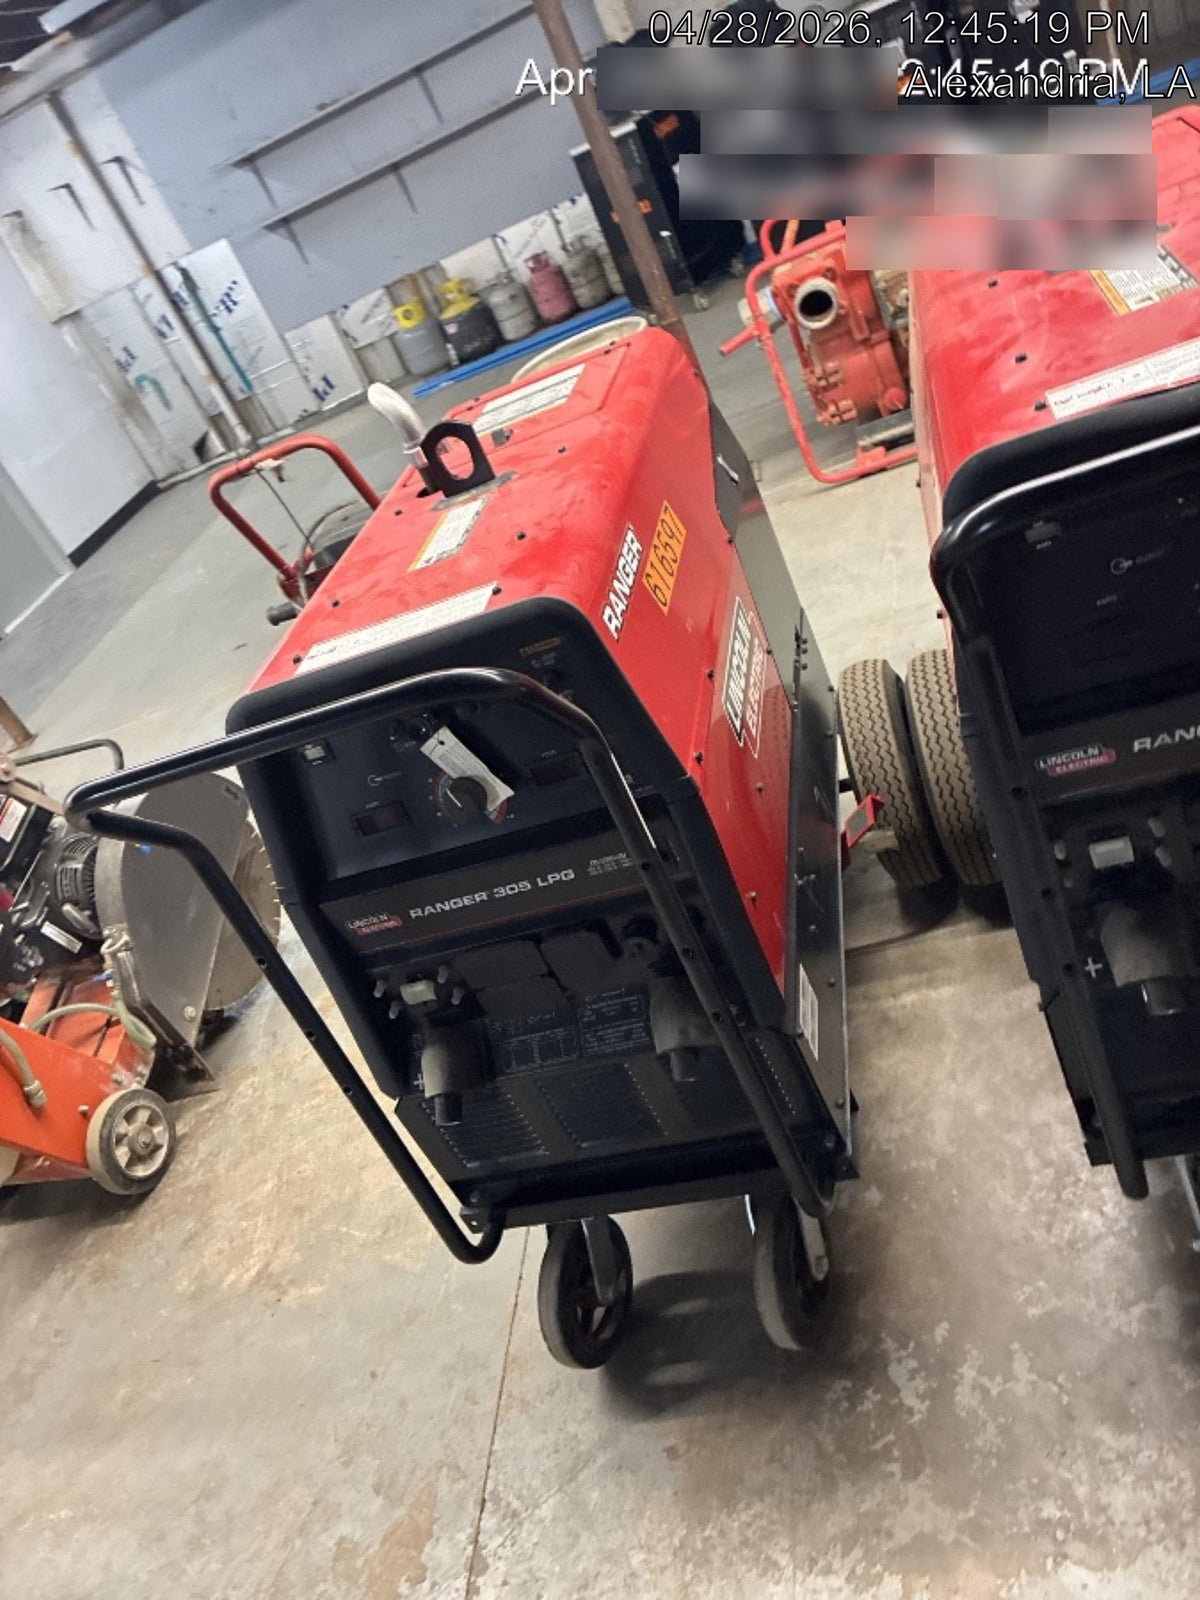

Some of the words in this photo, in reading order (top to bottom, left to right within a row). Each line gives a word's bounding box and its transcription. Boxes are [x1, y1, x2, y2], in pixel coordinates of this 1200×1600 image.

[602, 528, 643, 640] RANGER
[645, 505, 685, 607] 616597
[1132, 722, 1200, 753] RAN
[409, 890, 489, 919] RANGER
[493, 881, 532, 900] 305
[536, 868, 576, 890] LPG
